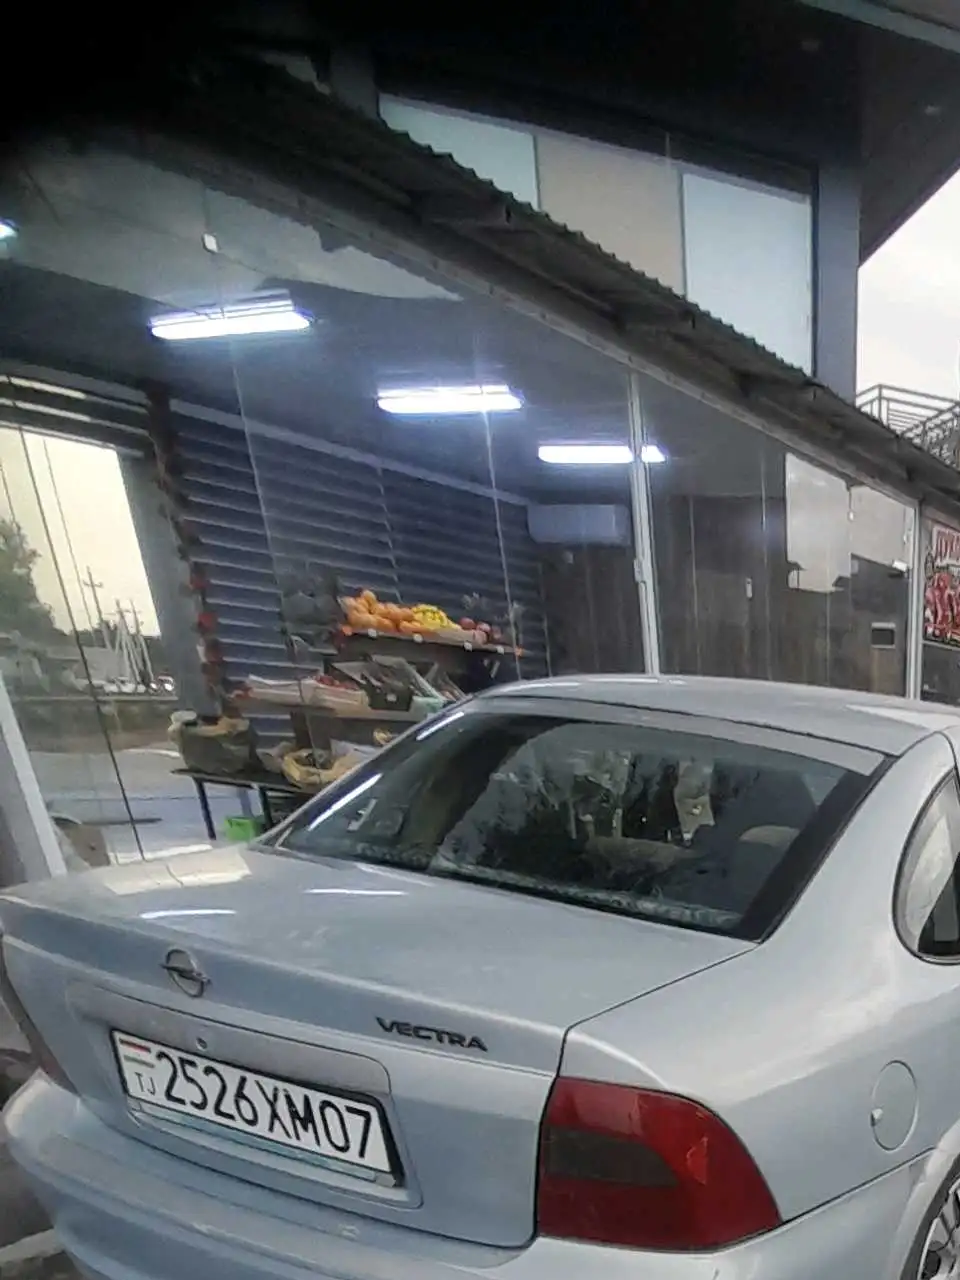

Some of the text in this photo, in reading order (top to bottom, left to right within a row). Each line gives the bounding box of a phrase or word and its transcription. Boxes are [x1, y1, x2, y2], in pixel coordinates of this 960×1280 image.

[375, 1016, 488, 1052] VECTRA
[134, 1071, 156, 1096] TJ
[155, 1051, 372, 1159] 2526XM07
